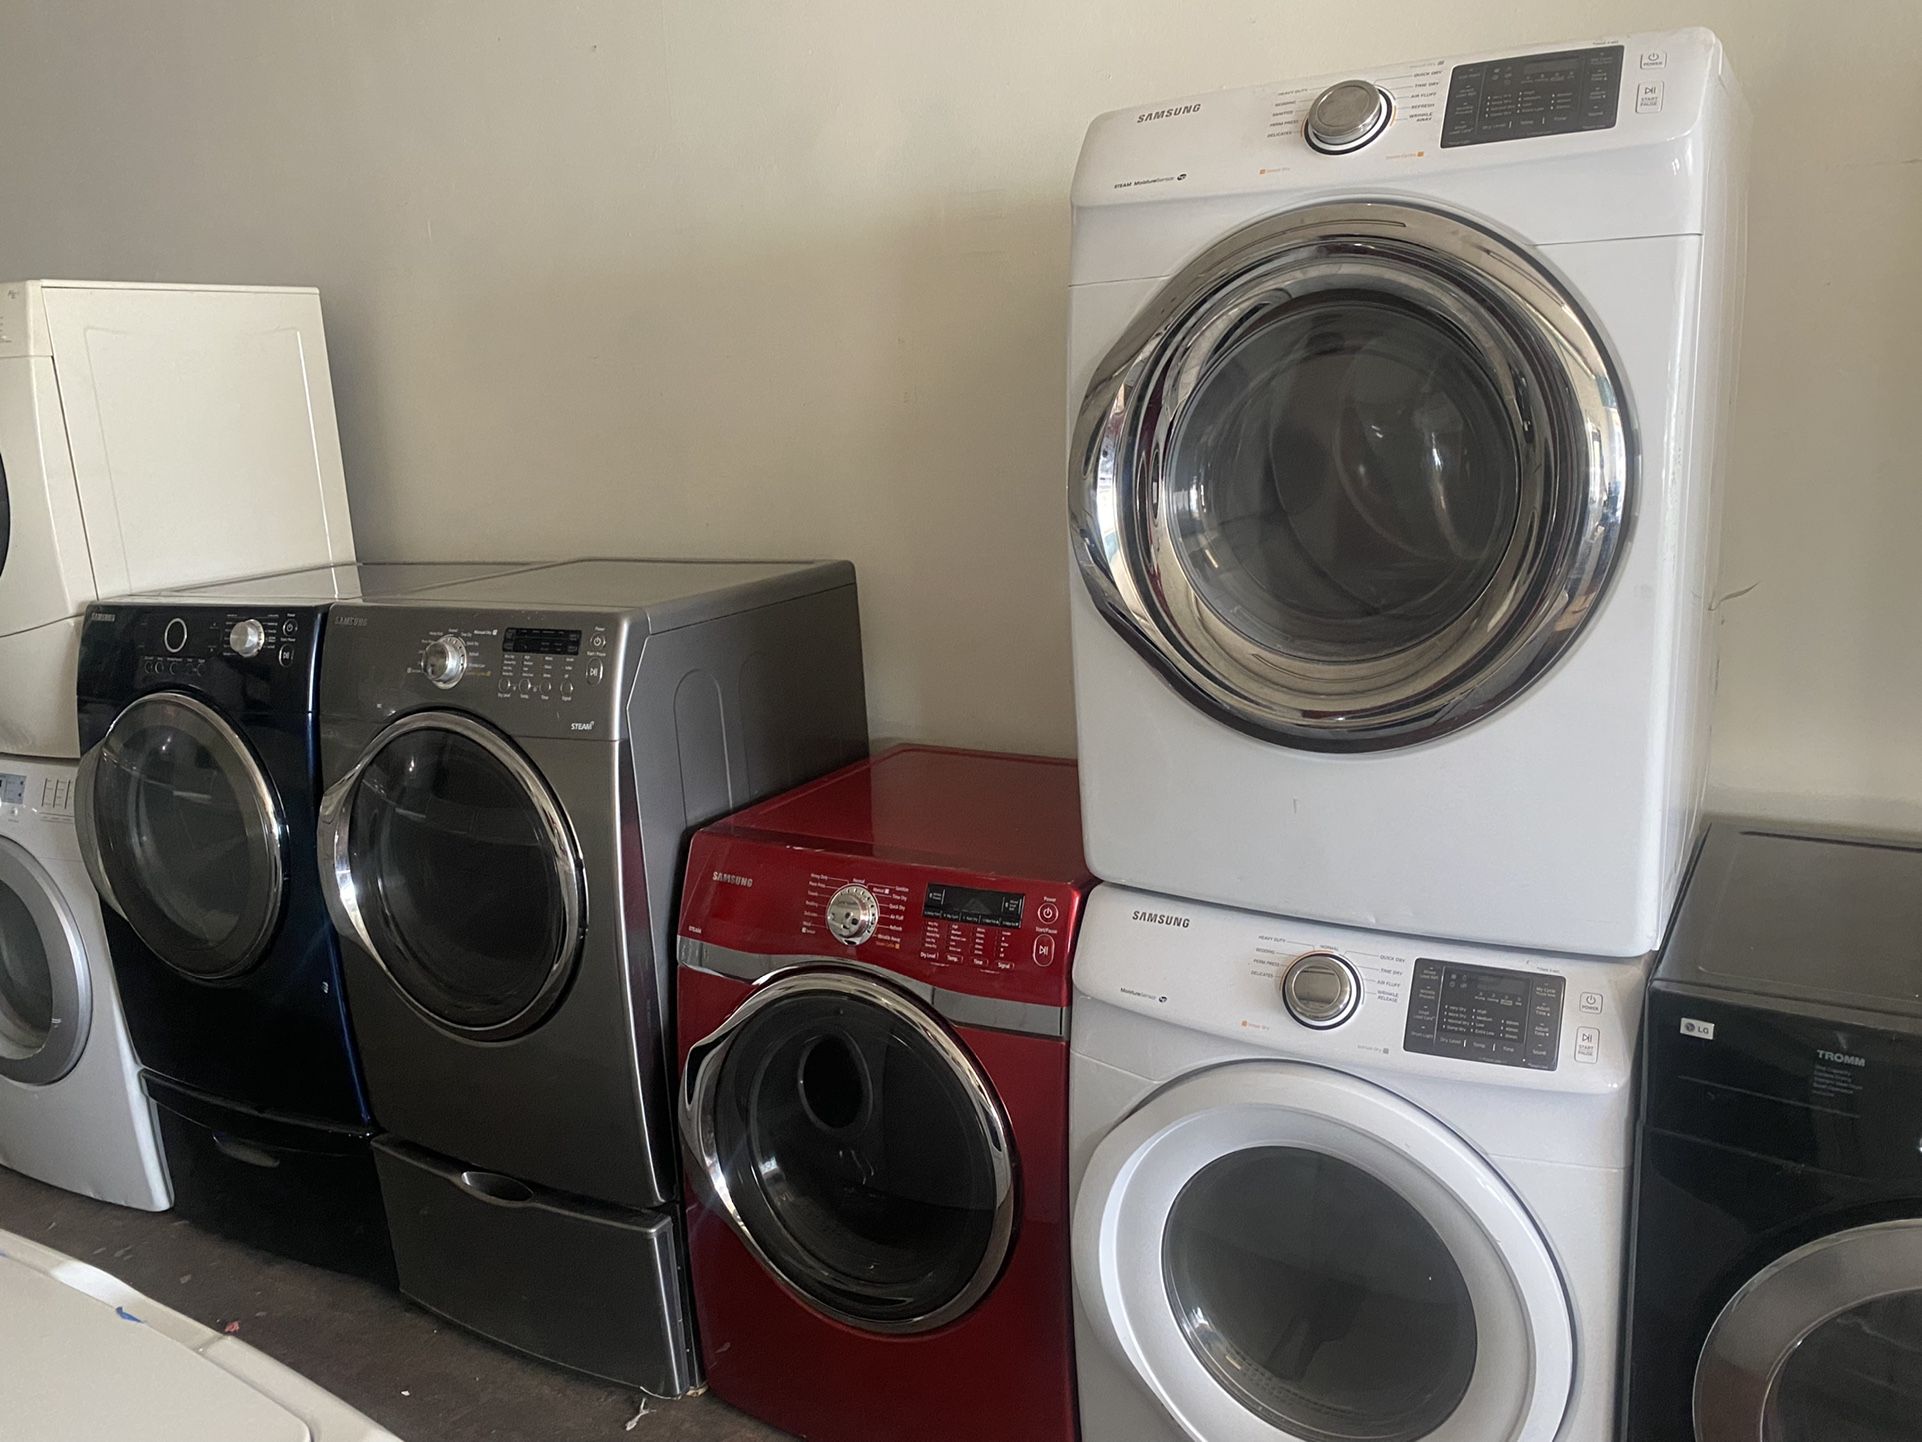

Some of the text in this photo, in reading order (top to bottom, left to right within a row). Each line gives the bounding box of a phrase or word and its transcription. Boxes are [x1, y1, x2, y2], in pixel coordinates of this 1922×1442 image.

[1136, 103, 1201, 124] SAMSUNG
[571, 722, 593, 730] STEAM
[712, 871, 753, 888] SAMSUNG
[1132, 910, 1190, 928] SAMSUNG
[1817, 1050, 1866, 1067] TROMM
